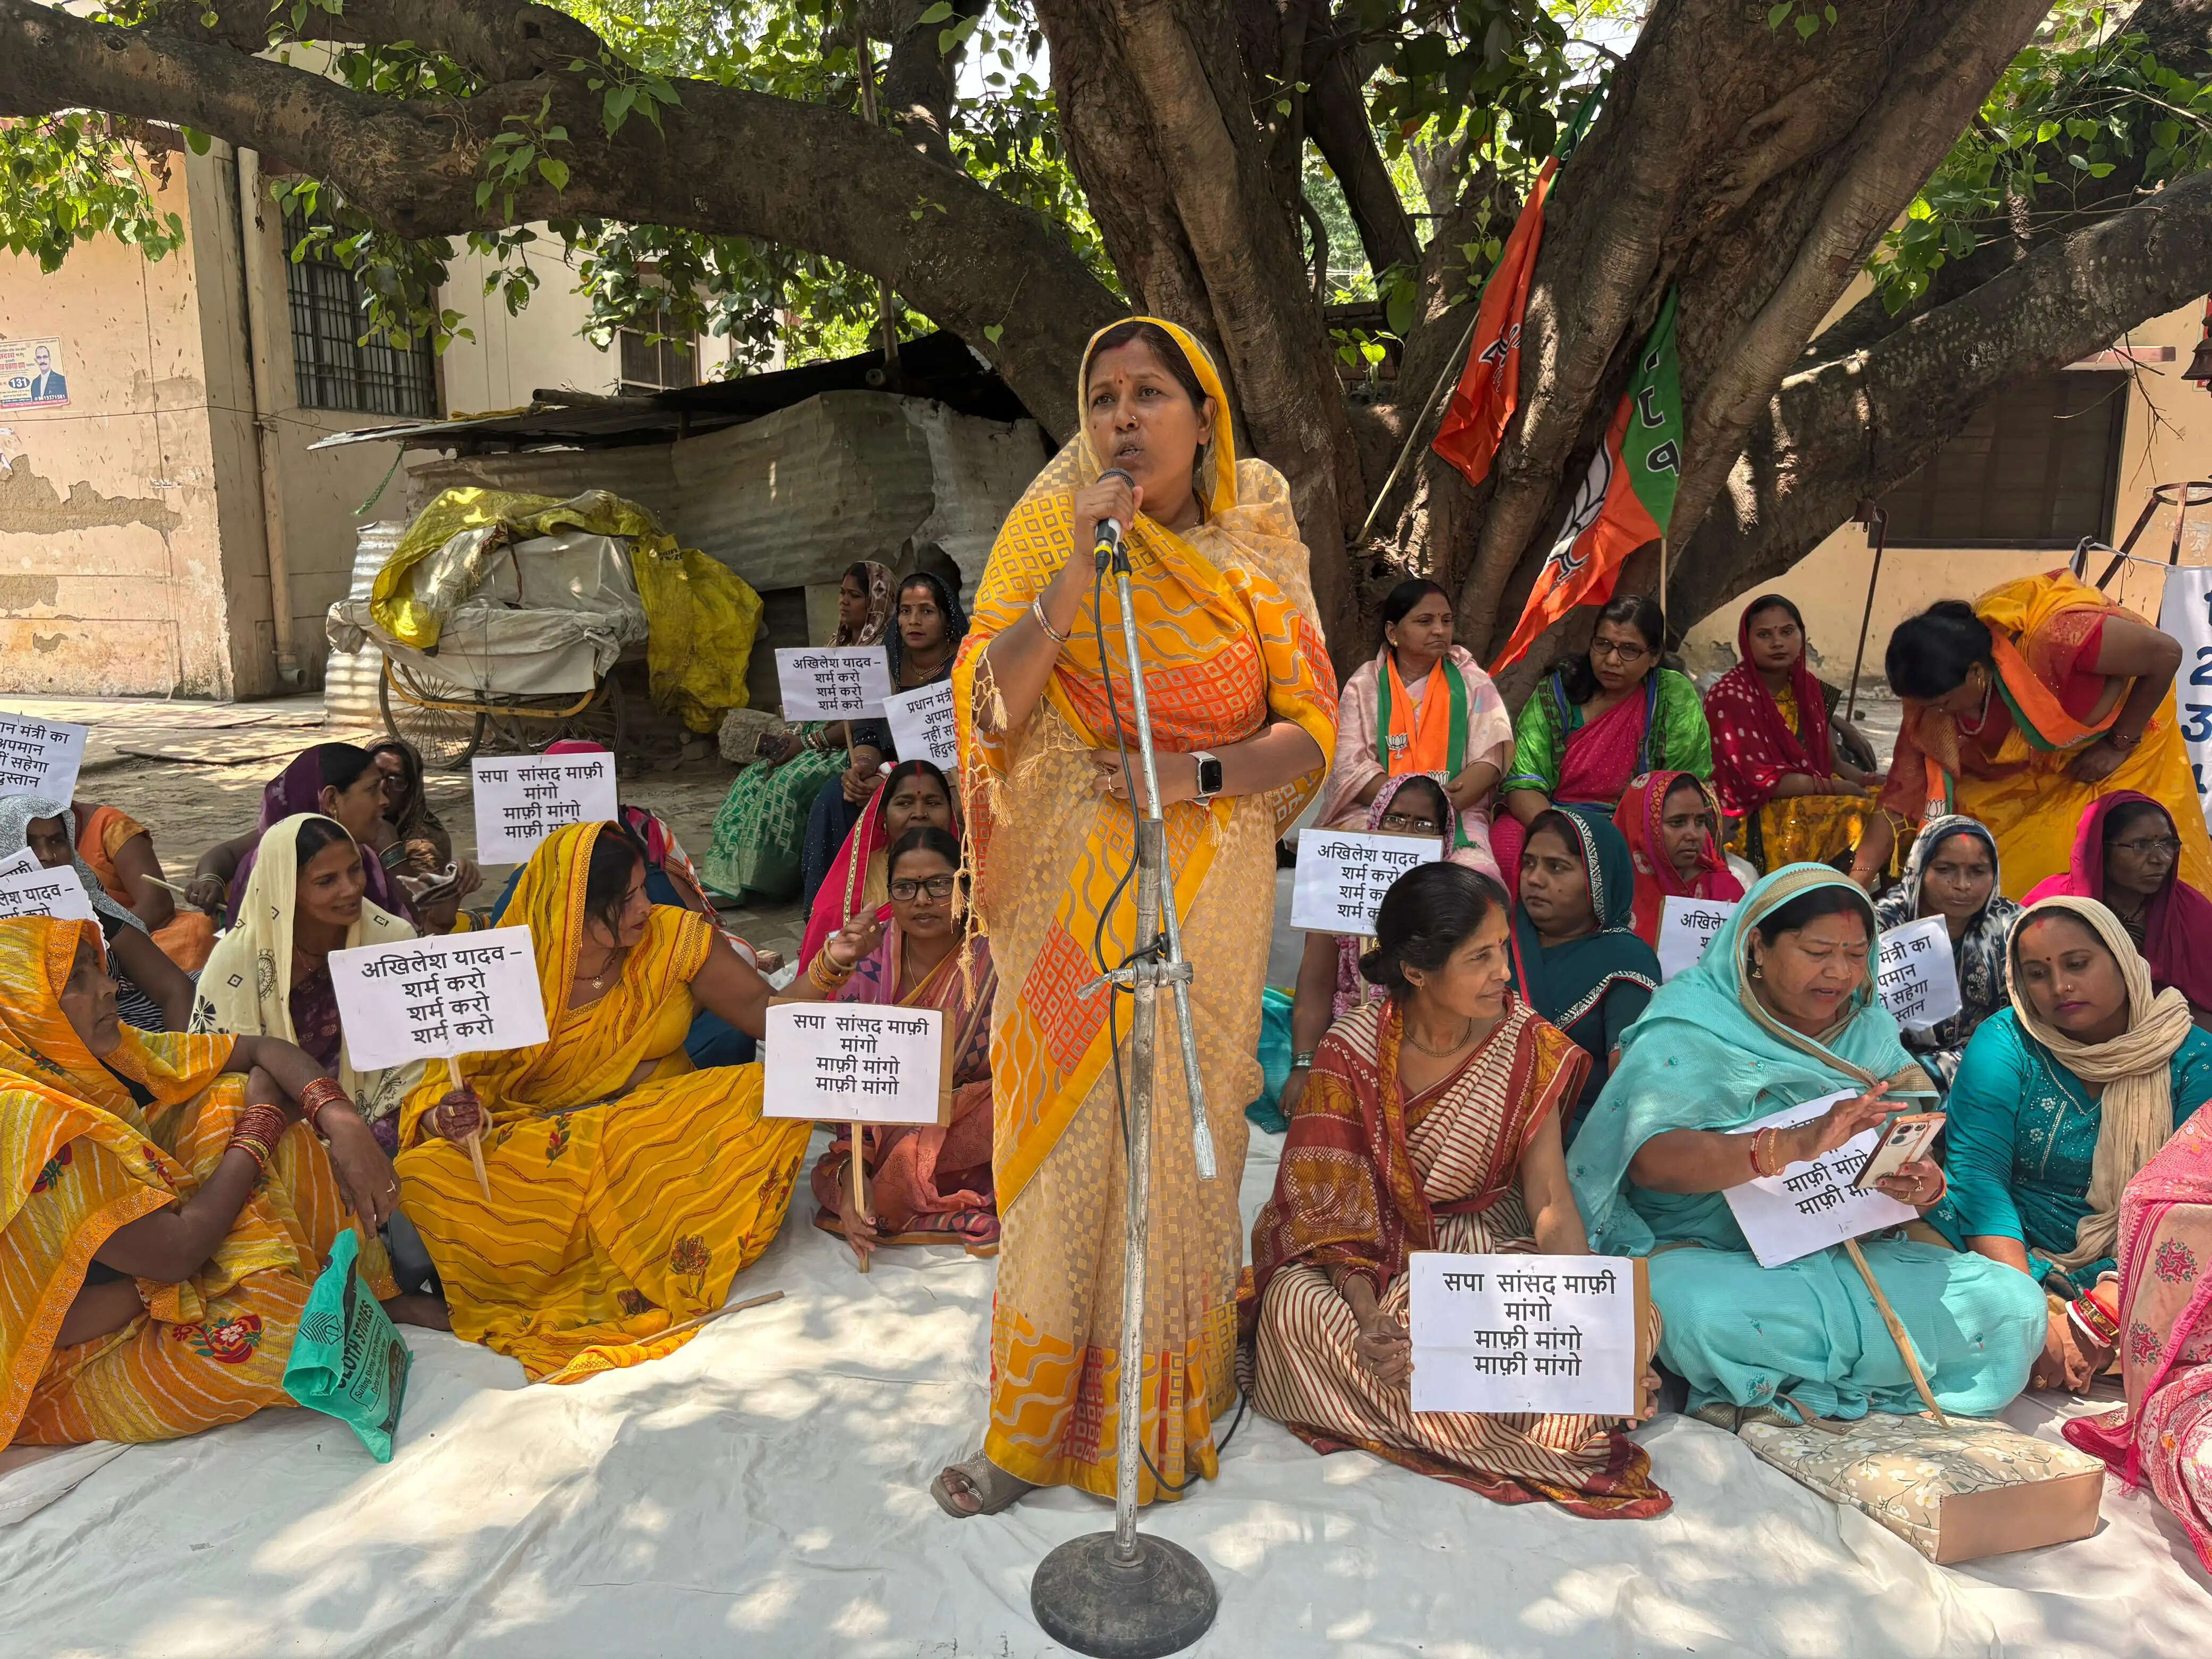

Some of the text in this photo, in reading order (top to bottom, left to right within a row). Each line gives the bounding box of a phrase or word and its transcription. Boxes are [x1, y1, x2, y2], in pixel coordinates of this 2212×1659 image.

[10, 378, 27, 387] 131
[793, 656, 839, 669] अखिलेश
[842, 658, 871, 668] यादव
[814, 669, 860, 683] शर्म करो
[816, 683, 861, 697] शर्म करो
[818, 697, 838, 710] शर्म
[907, 697, 934, 713] प्रधान
[925, 708, 953, 724] अपमा
[20, 724, 47, 739] मंत्री
[50, 731, 70, 743] का
[921, 726, 941, 742] नहीं
[11, 755, 49, 773] सहेगा
[477, 761, 604, 783] सपा सांसद माफ़ी
[523, 782, 558, 800] मांगो
[503, 800, 581, 819] माफ़ी मांगो
[504, 820, 543, 838] माफ़ी
[1318, 842, 1378, 862] अखिलेश
[1382, 851, 1419, 867] यादव
[1341, 864, 1401, 883] शर्म करो
[23, 884, 61, 901] यादव
[1339, 883, 1366, 900] शर्म
[1337, 901, 1364, 918] शर्म
[1681, 910, 1727, 930] अखिले
[1908, 936, 1931, 952] का
[362, 950, 448, 979] अखिलेश
[453, 946, 505, 966] यादव
[402, 968, 485, 999] शर्म करो
[1878, 964, 1916, 987] पमान
[1890, 976, 1928, 1007] सहेगा
[407, 991, 490, 1022] शर्म करो
[412, 1014, 494, 1044] शर्म करो
[793, 1015, 929, 1035] सपा सांसद माफ़ी
[840, 1034, 878, 1053] मांगो
[816, 1054, 900, 1074] माफ़ी मांगो
[815, 1075, 899, 1094] माफ़ी मांगो
[1783, 1163, 1833, 1193] माफ़ी
[1796, 1185, 1846, 1214] माफ़ी
[1443, 1269, 1616, 1295] सपा सांसद माफ़ी
[1504, 1296, 1552, 1321] मांगो
[353, 1300, 375, 1344] STORES
[1474, 1325, 1582, 1350] माफ़ी मांगो
[1473, 1352, 1582, 1376] माफ़ी मांगो
[355, 1377, 371, 1399] Suiting
